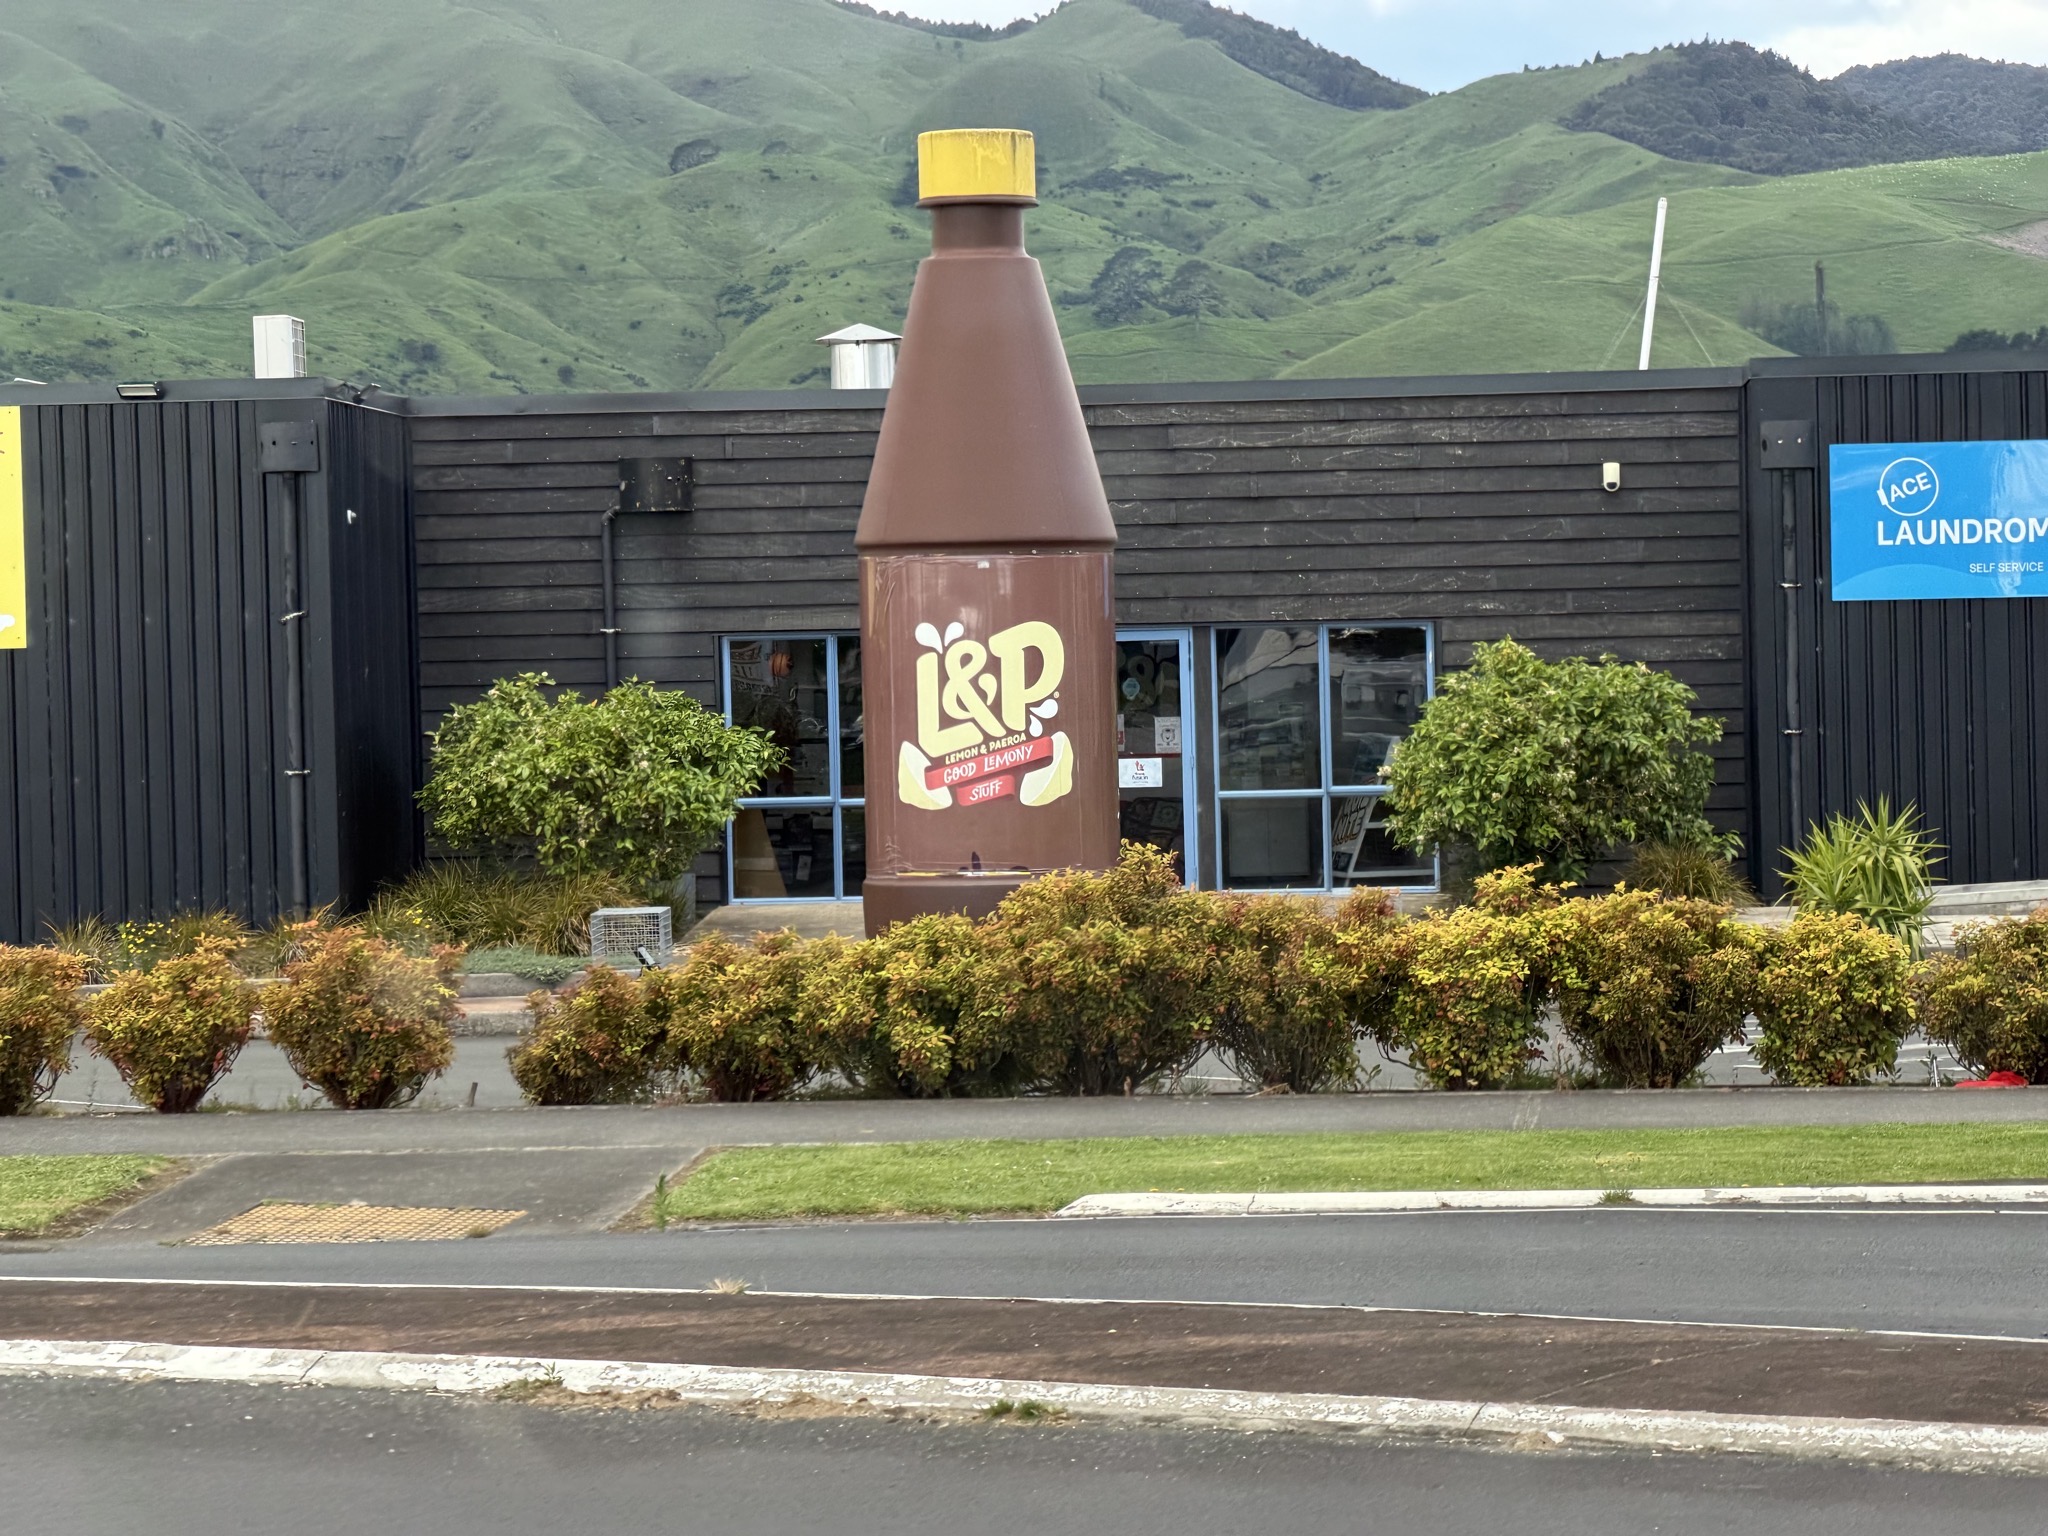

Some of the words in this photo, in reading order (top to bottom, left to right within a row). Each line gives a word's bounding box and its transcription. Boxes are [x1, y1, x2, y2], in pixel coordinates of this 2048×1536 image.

[1890, 472, 1932, 502] ACE
[1877, 517, 2048, 546] LAUNDROM
[1969, 563, 1996, 573] SELF
[1998, 561, 2044, 573] SERVICE
[916, 621, 1064, 758] L&P
[945, 745, 979, 765] LEMON
[979, 742, 988, 755] &
[989, 732, 1027, 752] PAEROA
[943, 764, 977, 784] GOOD
[984, 744, 1034, 773] LEMONY
[969, 780, 1003, 801] STUFF
